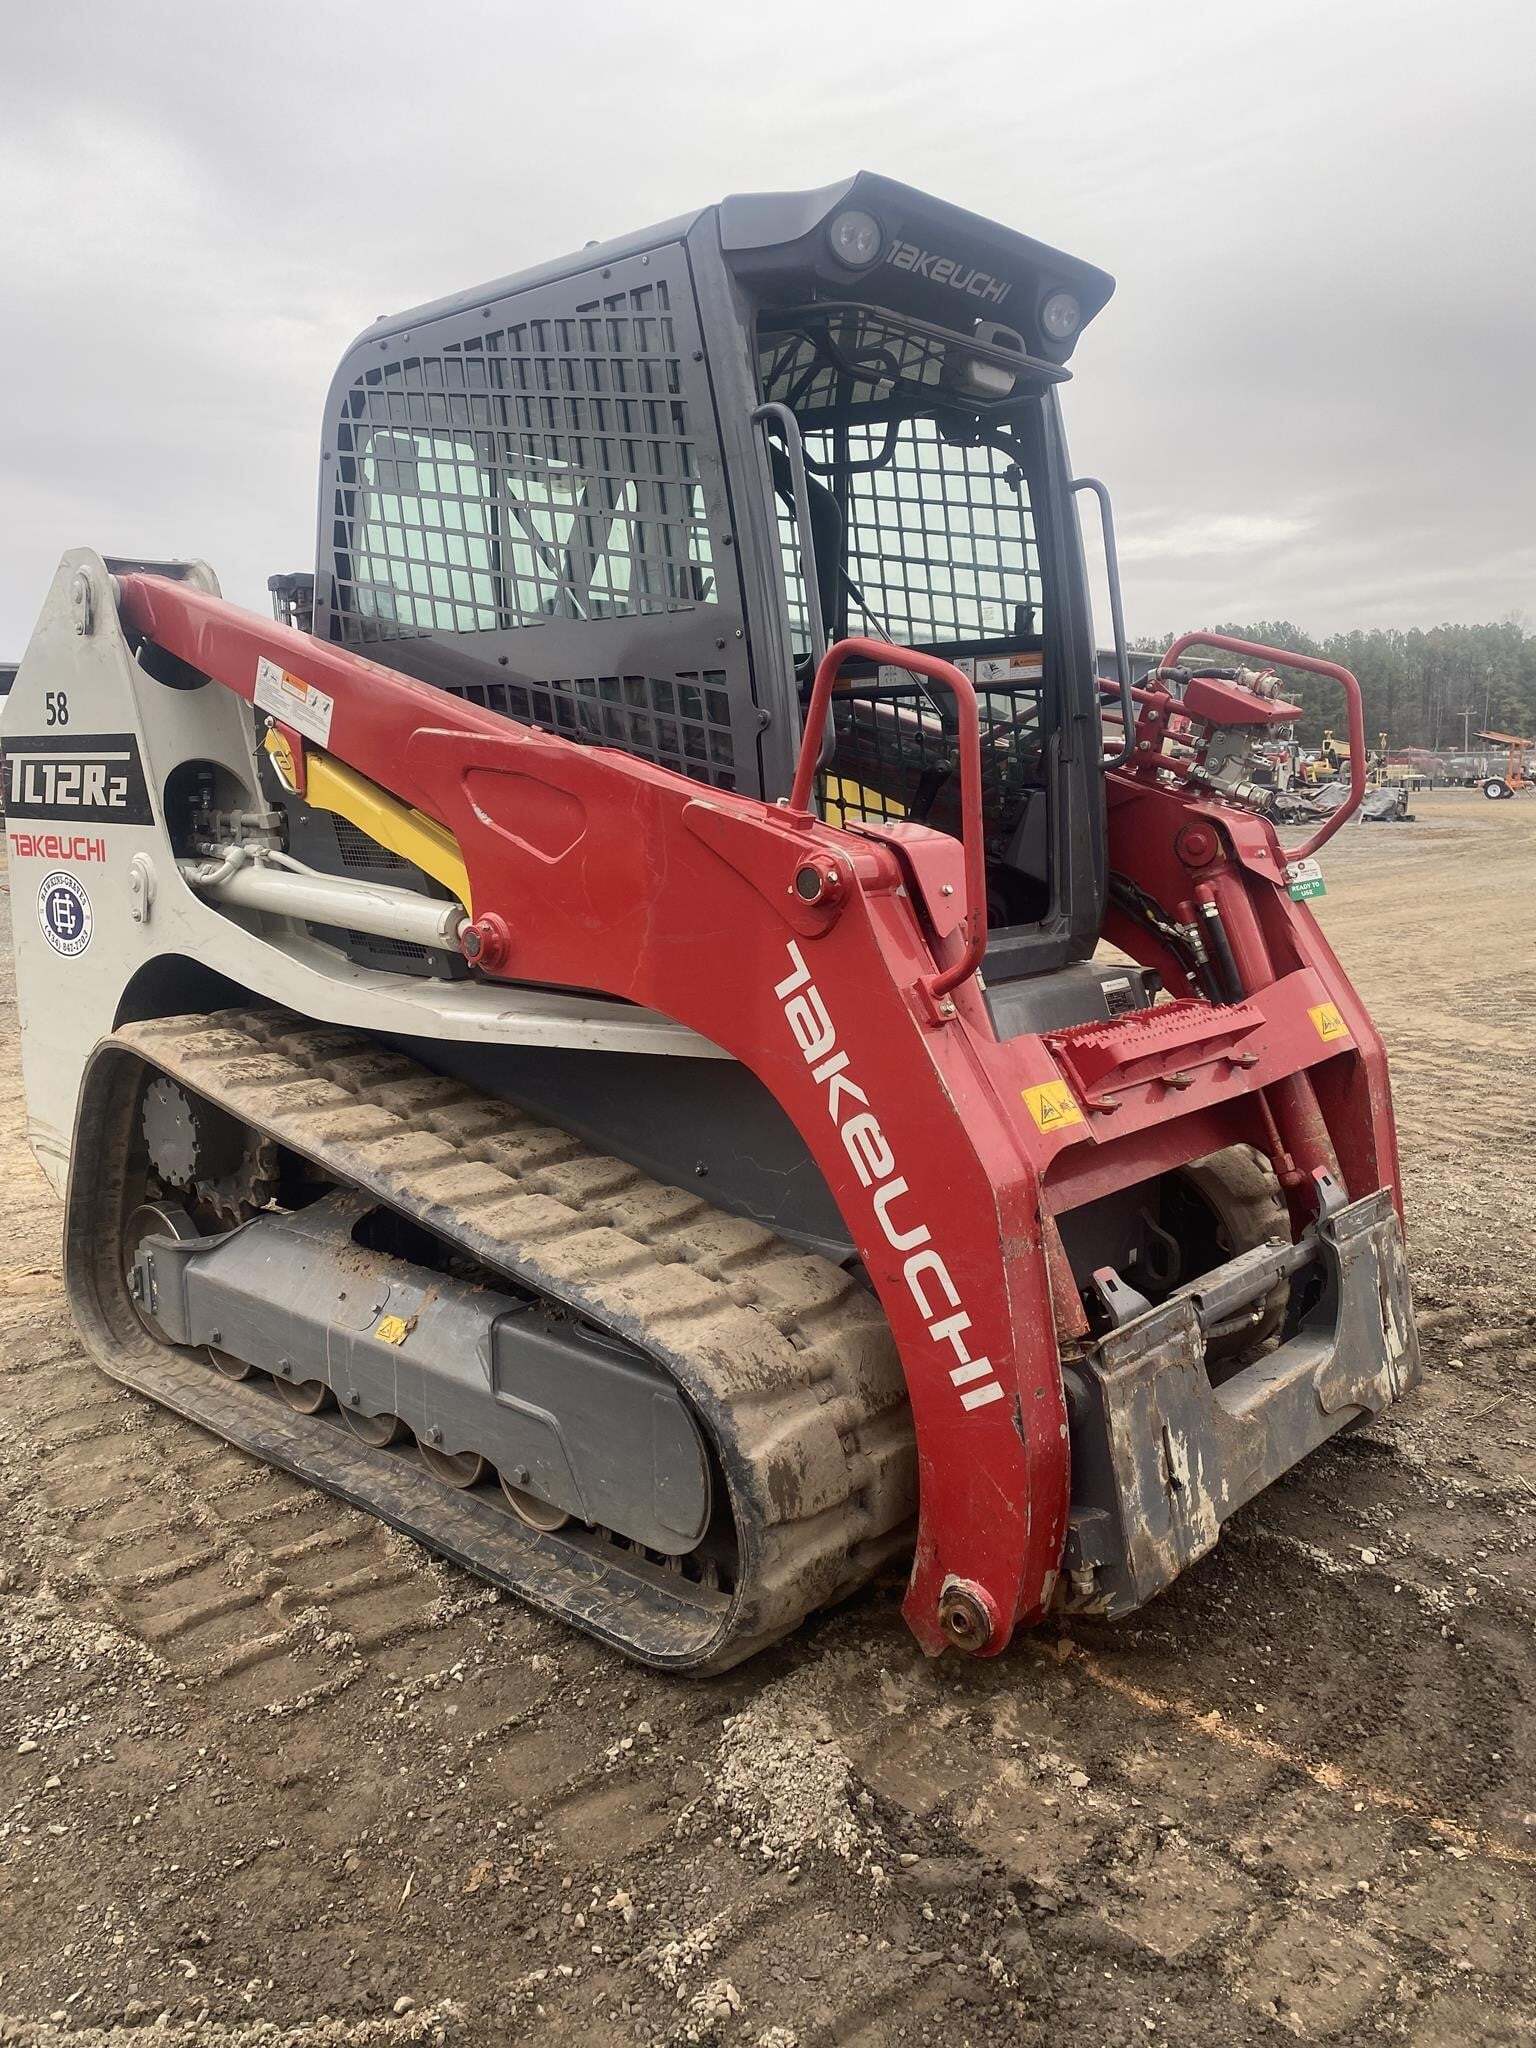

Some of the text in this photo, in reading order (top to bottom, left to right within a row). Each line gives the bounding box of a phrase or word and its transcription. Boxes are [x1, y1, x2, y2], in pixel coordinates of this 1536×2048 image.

[45, 691, 69, 726] 58
[5, 752, 131, 807] TL12R2
[1291, 881, 1320, 892] READY TO
[1300, 889, 1314, 897] USE
